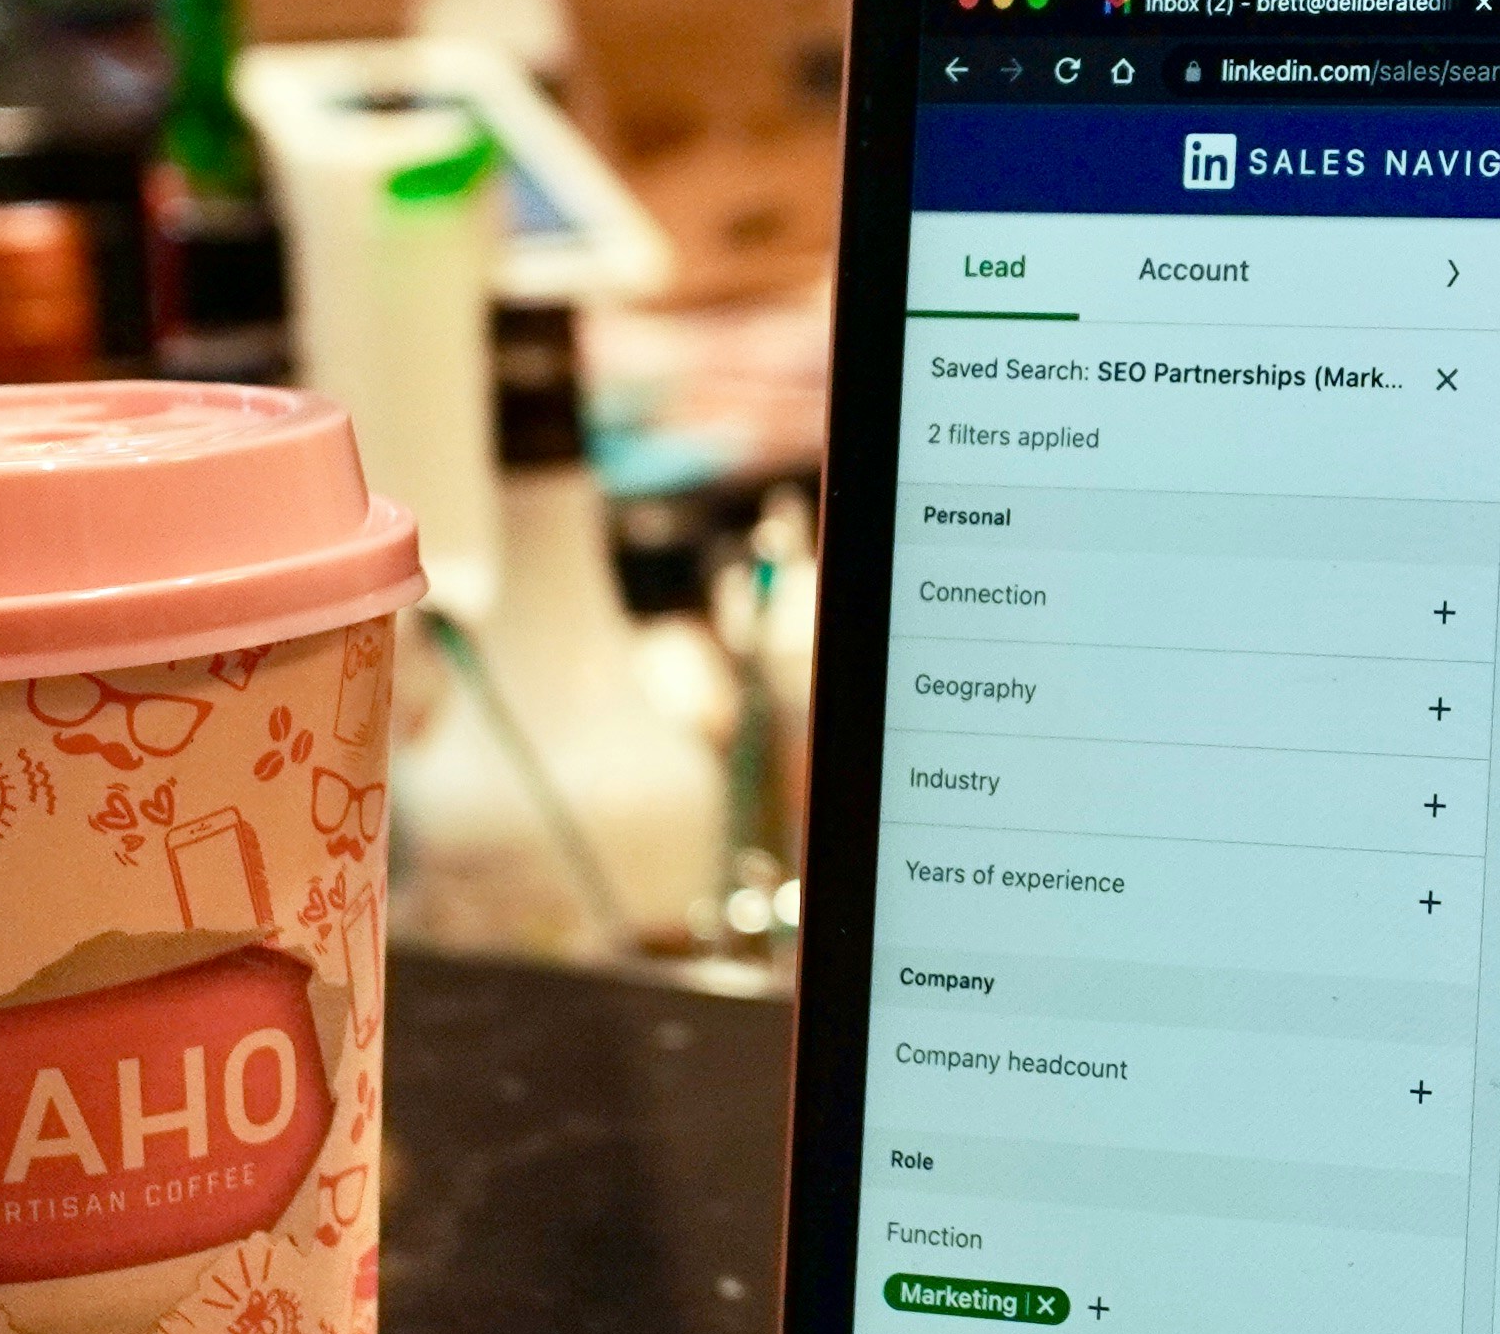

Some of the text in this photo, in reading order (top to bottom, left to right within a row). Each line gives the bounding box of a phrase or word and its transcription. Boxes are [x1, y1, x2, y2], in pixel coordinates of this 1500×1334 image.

[1190, 141, 1229, 183] in
[1248, 147, 1365, 177] SALES
[964, 254, 1026, 279] Lead
[1138, 257, 1250, 283] Account
[931, 356, 999, 379] Saved
[1006, 358, 1090, 381] Search:
[1097, 360, 1147, 383] SEO
[1154, 362, 1306, 391] Partnerships
[927, 422, 1100, 452] 2 filters applied
[923, 505, 1011, 527] Personal
[919, 580, 1047, 607] Connection
[914, 673, 1037, 705] Geography
[910, 766, 1001, 797] Industry
[905, 859, 1125, 894] Years of experience
[899, 967, 995, 995] Company
[895, 1041, 1128, 1081] Company headcount
[890, 1149, 934, 1171] Role
[145, 1163, 257, 1208] COFFEE
[887, 1221, 983, 1250] Function
[899, 1281, 1018, 1318] Marketing
